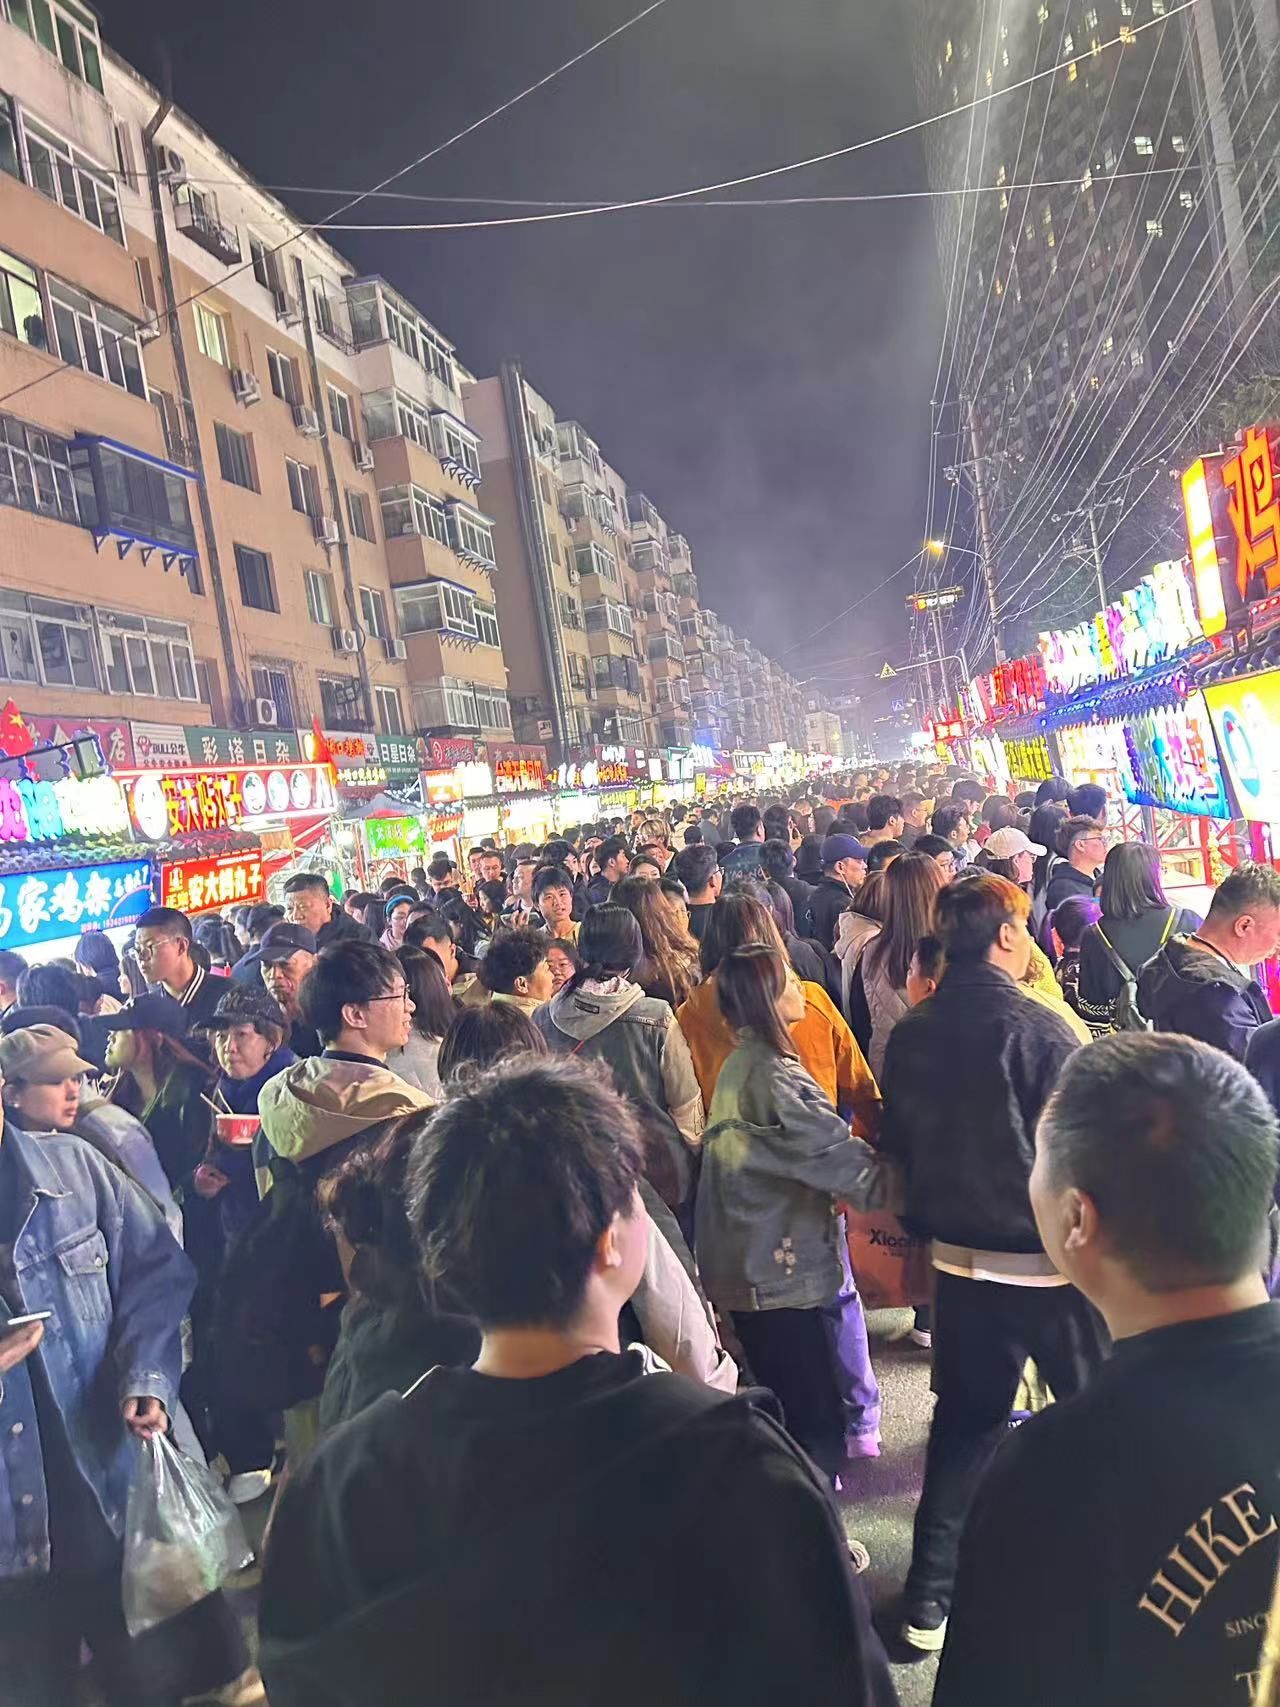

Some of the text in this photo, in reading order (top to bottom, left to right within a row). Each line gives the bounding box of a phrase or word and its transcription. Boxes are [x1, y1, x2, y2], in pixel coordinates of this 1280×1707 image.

[1221, 427, 1280, 602] 鸡
[201, 735, 291, 765] 彩塔日杂
[380, 743, 416, 764] 日星日杂
[1138, 1482, 1279, 1638] HIKE
